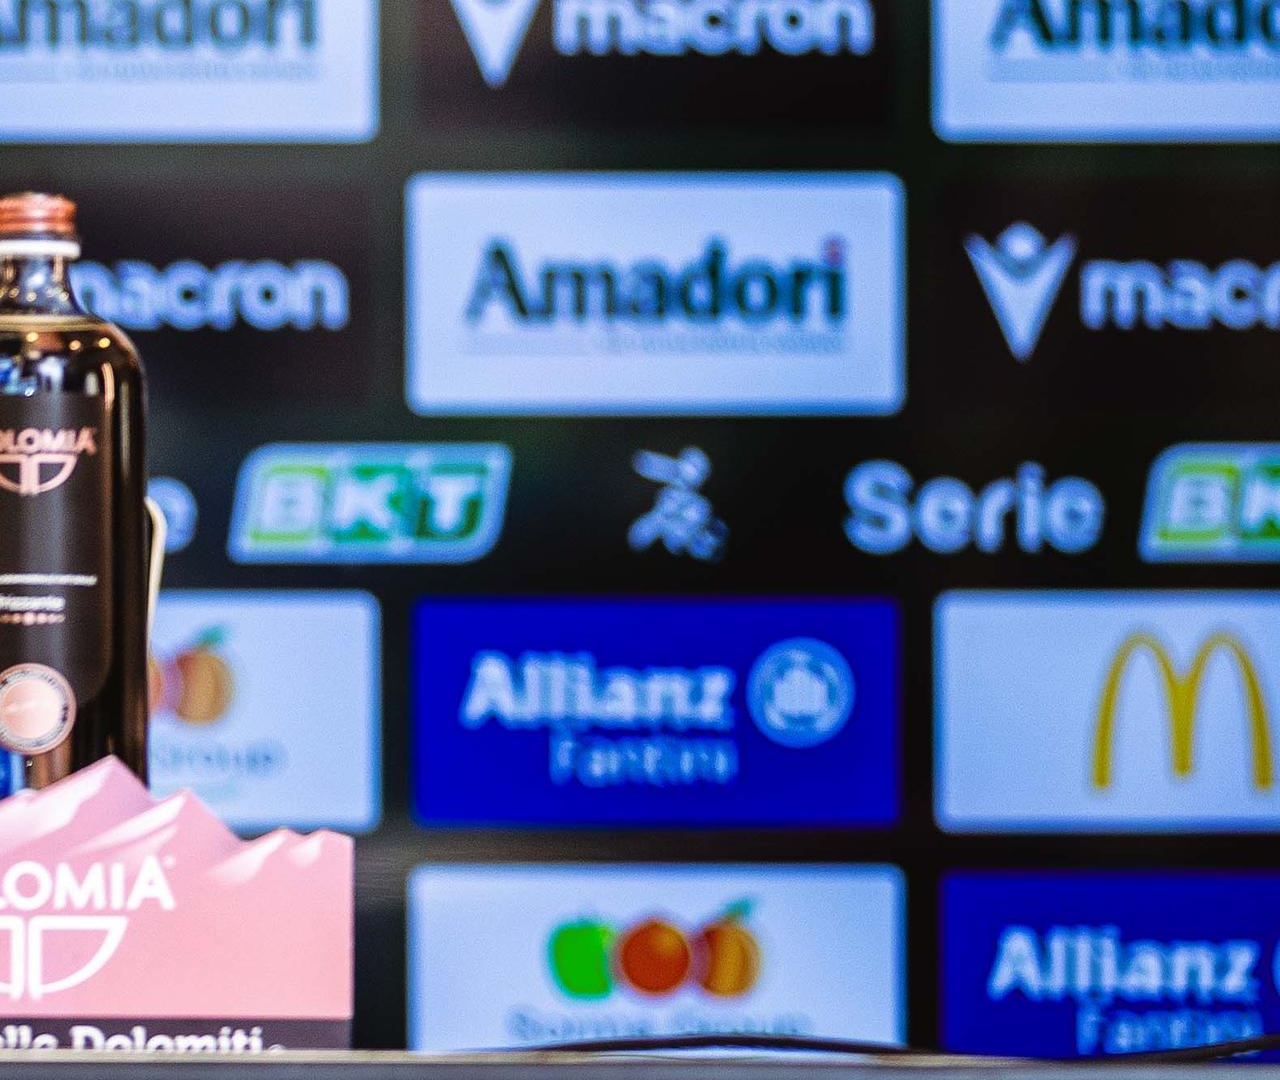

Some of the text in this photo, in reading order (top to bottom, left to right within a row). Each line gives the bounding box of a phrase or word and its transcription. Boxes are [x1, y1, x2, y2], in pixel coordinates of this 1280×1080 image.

[462, 236, 850, 326] Amadori
[258, 472, 484, 536] BKT
[845, 461, 1103, 553] Serie
[463, 654, 731, 728] Allianz
[988, 924, 1262, 1004] Allianz
